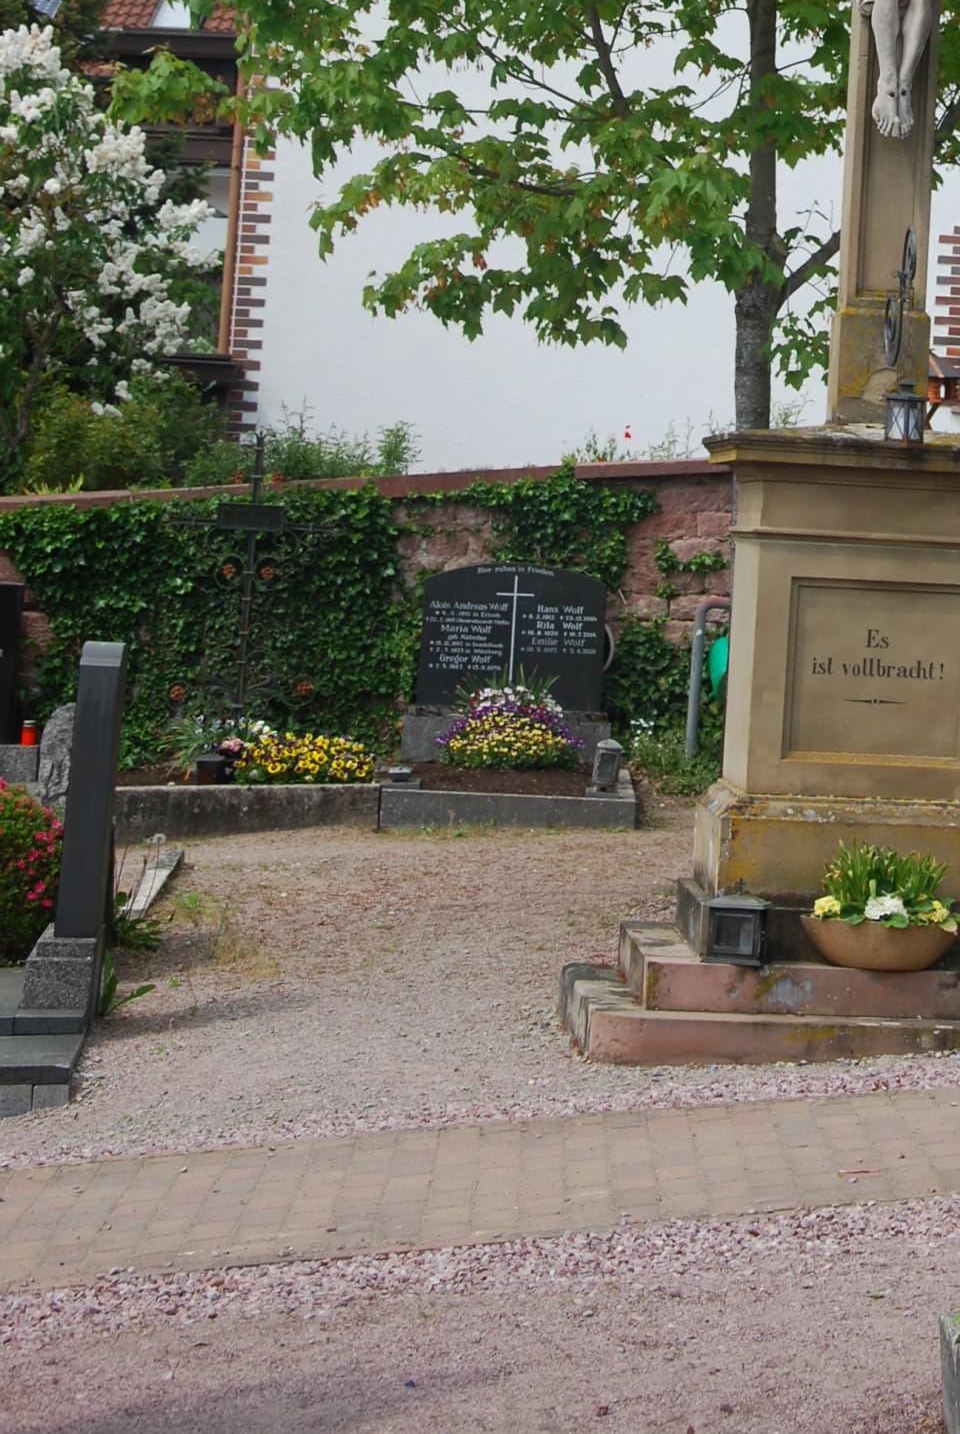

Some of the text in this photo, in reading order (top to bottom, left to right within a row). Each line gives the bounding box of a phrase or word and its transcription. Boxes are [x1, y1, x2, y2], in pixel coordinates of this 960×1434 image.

[537, 604, 584, 615] Hans Wolf
[440, 624, 492, 634] Maria Wolf
[536, 620, 583, 631] Rita Wolf
[563, 637, 585, 647] Wolf
[865, 628, 890, 650] Es
[439, 653, 492, 664] Gregor Wolf
[811, 657, 945, 681] ist vollbracht!
